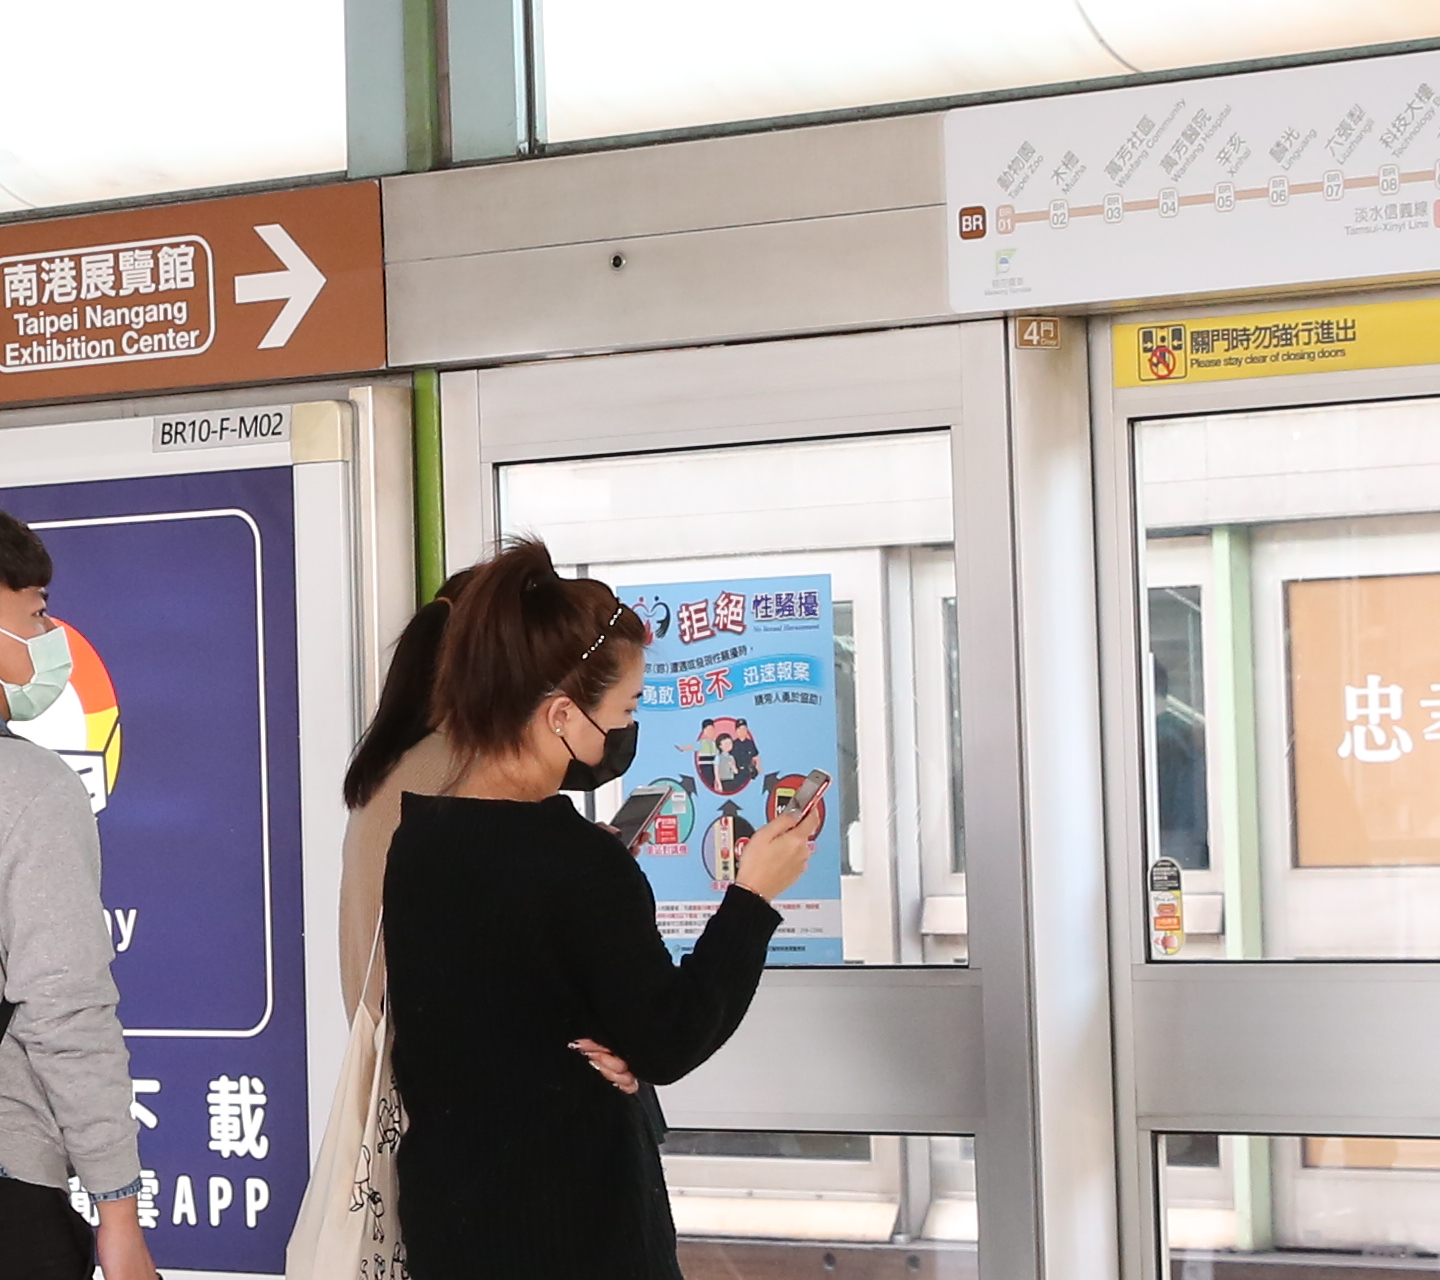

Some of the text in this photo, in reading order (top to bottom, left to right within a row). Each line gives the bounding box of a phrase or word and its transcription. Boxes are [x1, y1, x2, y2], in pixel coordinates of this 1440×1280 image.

[1326, 184, 1341, 197] 07
[1381, 178, 1397, 191] 08
[1217, 196, 1232, 208] 05
[1271, 190, 1286, 203] 06
[1106, 207, 1120, 219] 03
[1161, 202, 1176, 214] 04
[962, 216, 983, 232] BR
[1052, 213, 1066, 225] 02
[3, 244, 196, 309] 南港展覽館
[14, 300, 188, 337] Taipei Nangang
[1190, 318, 1356, 354] 關門時勿強行進出
[5, 329, 200, 366] Exhibition Center
[1190, 348, 1346, 368] Please stay clear of closing doors
[160, 413, 283, 445] BR10-F-M02
[677, 590, 820, 644] 拒絕 性騷擾
[678, 668, 733, 708] 說不
[743, 661, 811, 687] 迅速報案
